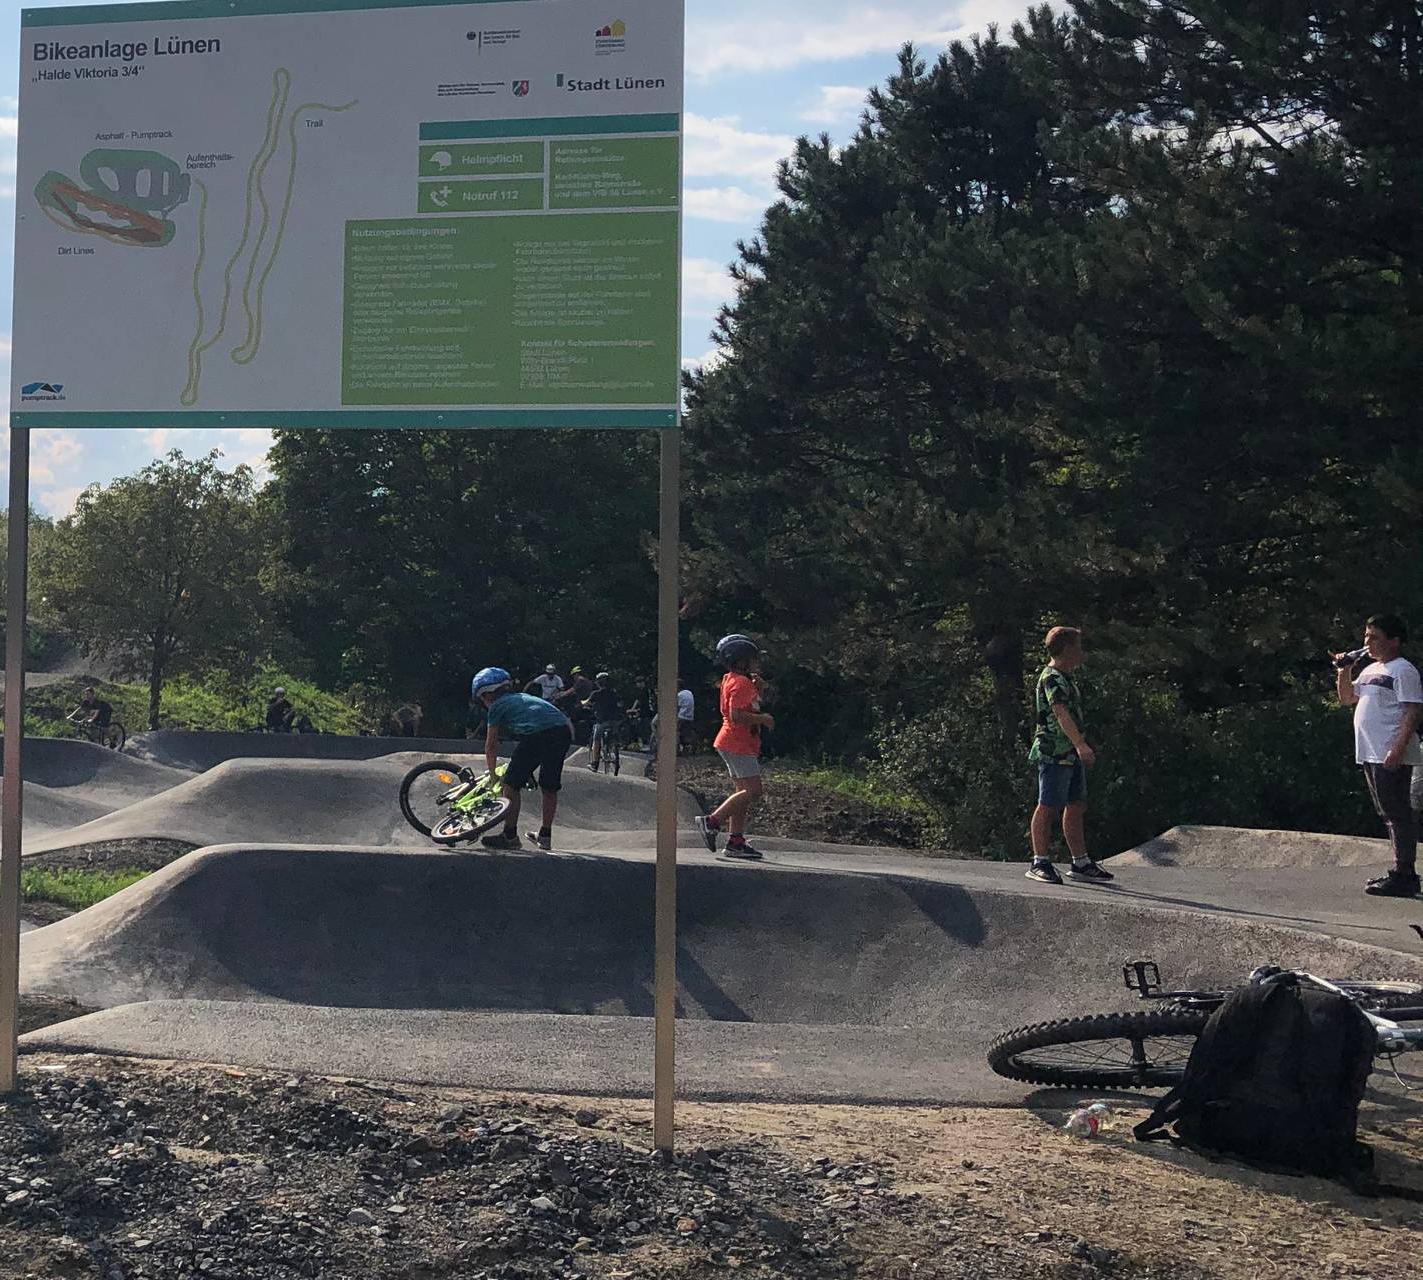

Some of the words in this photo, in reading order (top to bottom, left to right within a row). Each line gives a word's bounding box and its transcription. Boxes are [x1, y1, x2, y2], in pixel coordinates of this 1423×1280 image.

[33, 39, 148, 61] Bikeanlage
[154, 36, 221, 55] Lünen
[74, 66, 118, 79] Viktoria
[567, 78, 609, 91] Stadt
[616, 77, 665, 90] Lünen
[305, 119, 323, 128] Trail
[95, 132, 124, 141] Asphalt
[131, 131, 173, 141] Pumptrack
[186, 161, 216, 169] bereich
[462, 154, 523, 166] Helmpflicht
[463, 191, 498, 201] Notruf
[501, 190, 519, 200] 112
[58, 247, 71, 255] Dirt
[74, 247, 94, 255] Lines
